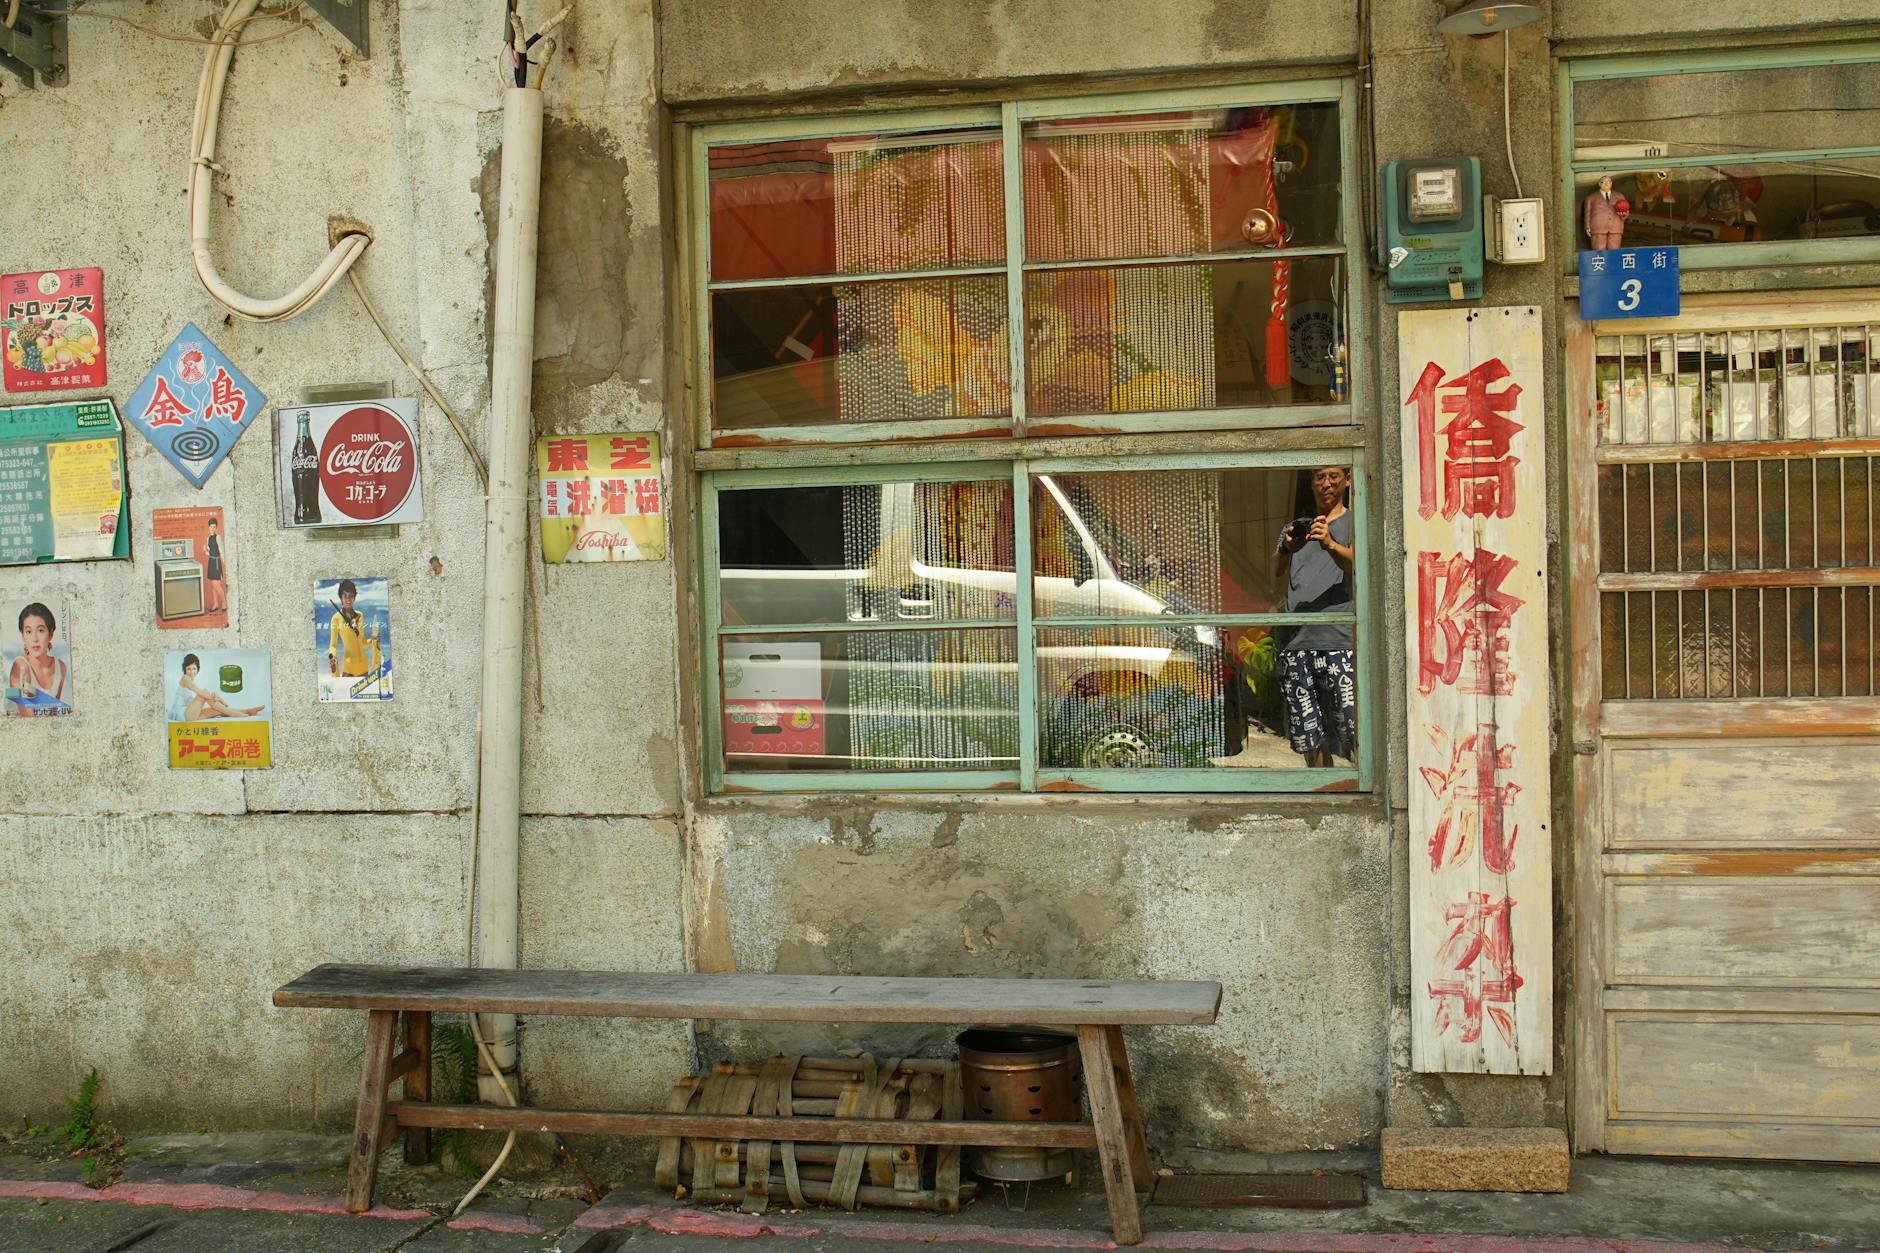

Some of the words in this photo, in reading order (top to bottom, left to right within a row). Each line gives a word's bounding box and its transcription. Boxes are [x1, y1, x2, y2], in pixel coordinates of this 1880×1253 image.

[1591, 252, 1667, 272] 安西街
[1617, 278, 1642, 311] 3
[8, 295, 94, 318] ドロップス
[140, 366, 248, 429] 金鳥
[351, 433, 380, 443] DRINK
[547, 436, 652, 472] 東芝
[345, 484, 387, 501] コカ・コーラ
[566, 479, 660, 516] 洗濯機
[576, 530, 628, 551] Toshiba
[176, 726, 219, 736] かとり線香
[177, 738, 261, 759] アース渦巻
